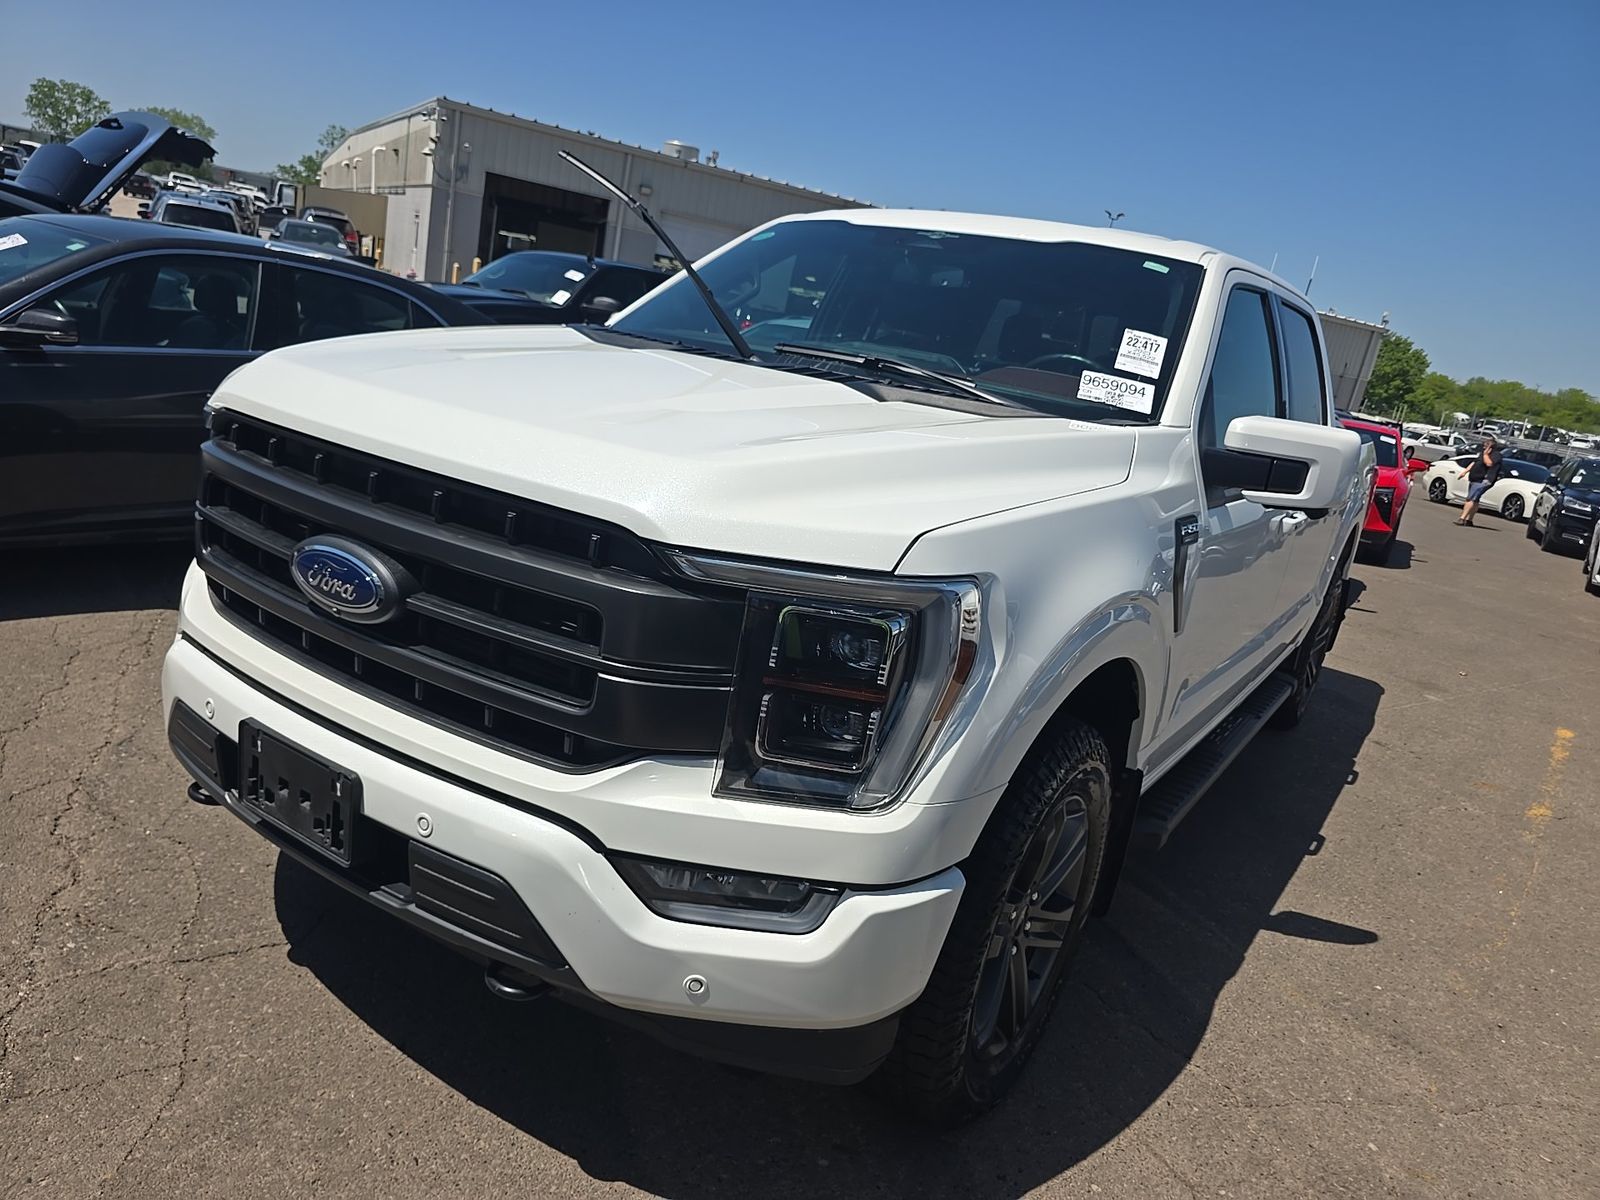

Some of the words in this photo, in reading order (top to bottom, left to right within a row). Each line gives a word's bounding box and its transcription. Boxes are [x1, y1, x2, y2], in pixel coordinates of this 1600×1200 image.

[1126, 336, 1161, 353] 22:417
[1082, 374, 1146, 398] 9659094
[307, 557, 358, 601] Ford
